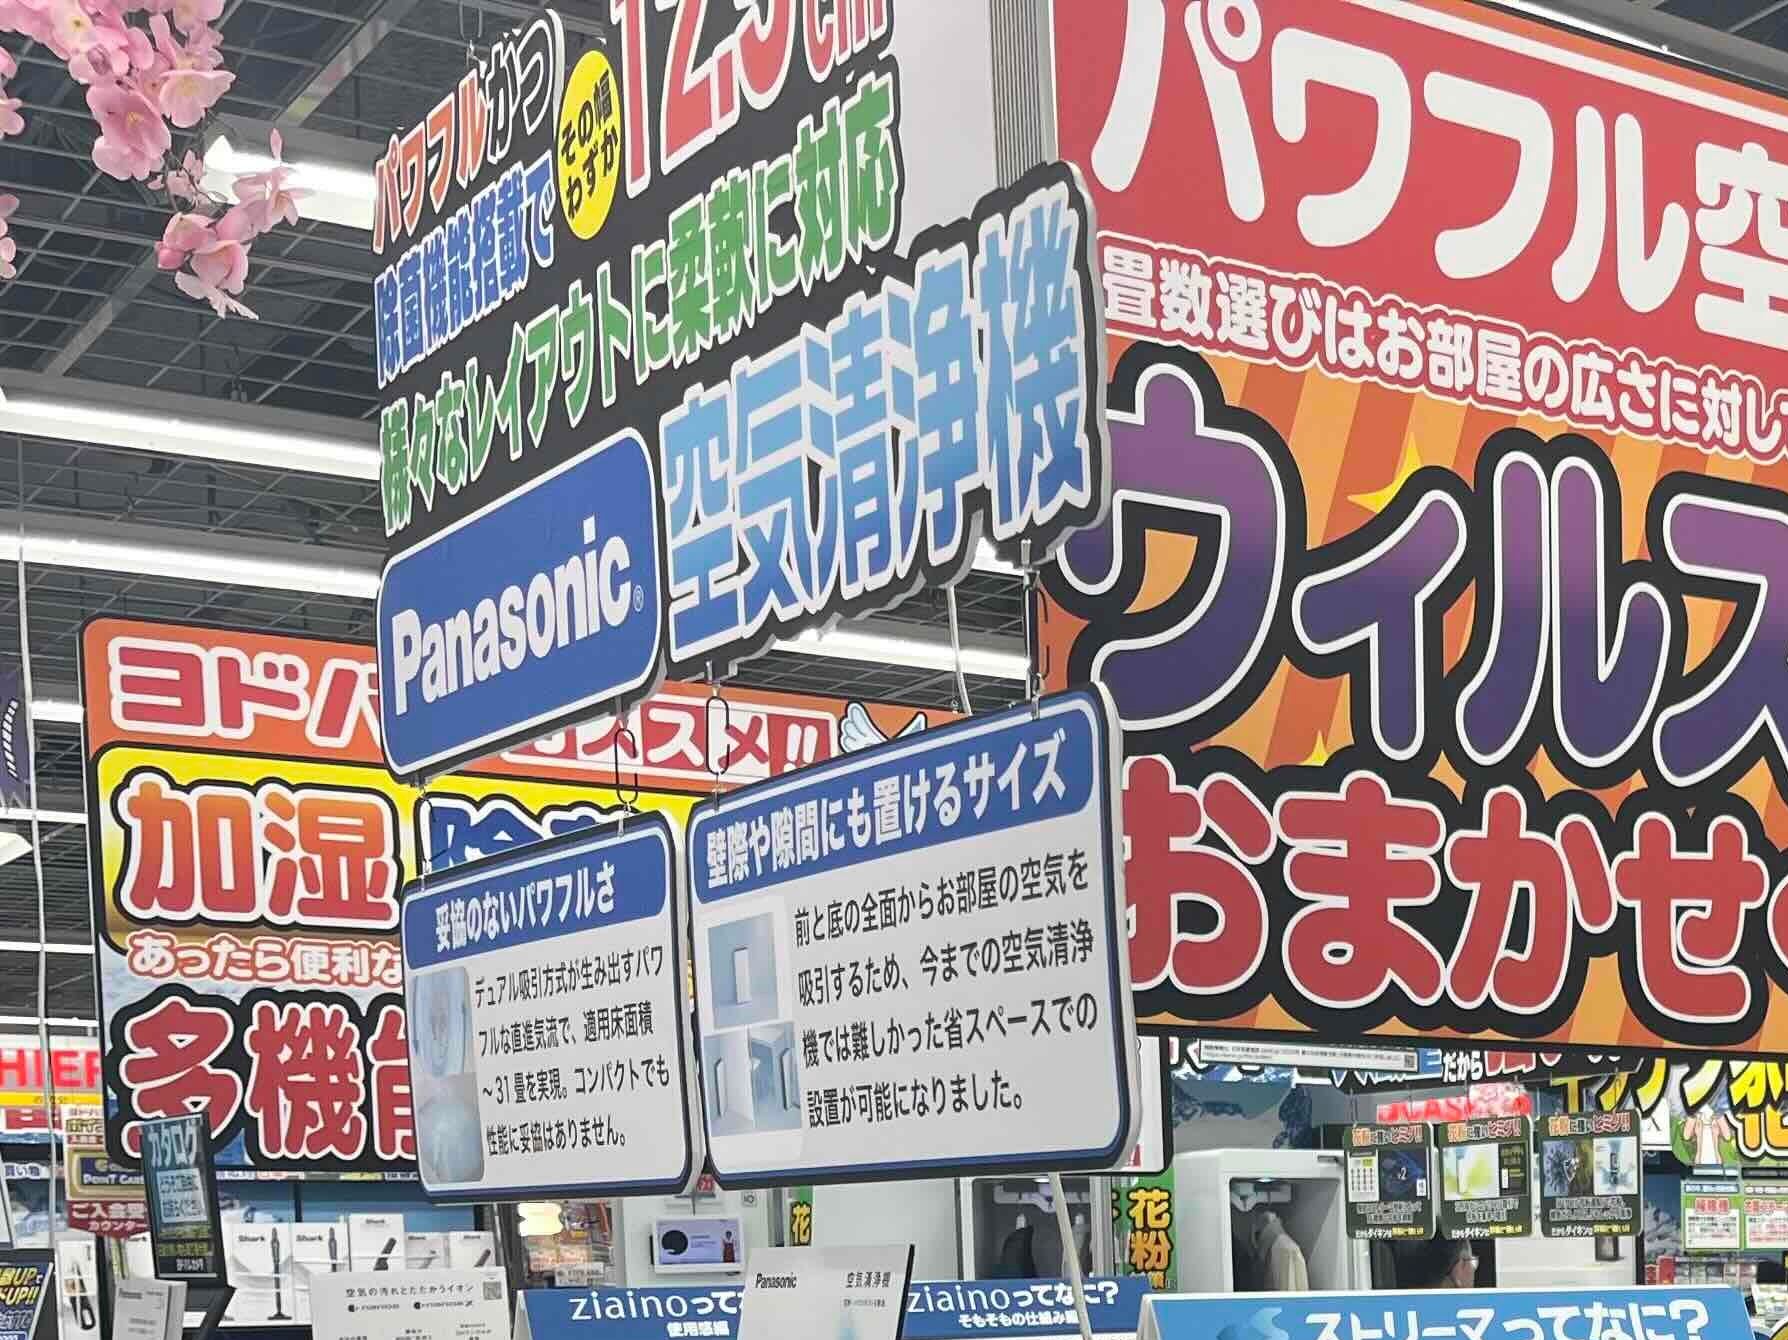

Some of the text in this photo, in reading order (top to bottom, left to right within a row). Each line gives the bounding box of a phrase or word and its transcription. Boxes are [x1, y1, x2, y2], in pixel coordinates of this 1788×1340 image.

[374, 150, 556, 390] 除菌機能搭載で
[378, 73, 897, 536] 様々なレイアウトに柔軟に対応
[658, 182, 1092, 664] 空気清浄機
[391, 517, 631, 717] Panasonic
[120, 777, 402, 926] 加湿
[705, 727, 1069, 889] 壁際や隙間にも置けるサイズ
[434, 860, 617, 953] 妥協のないパワフルさ
[792, 848, 1091, 948] 前と底の全面からお部屋の空気を
[473, 945, 664, 1009] デュアル吸引方式が生み出すパワ
[797, 917, 1095, 1009] 吸引するため、今までの空気清浄
[478, 1000, 654, 1058] フルな直進気流で、適用床面積
[800, 991, 1099, 1071] 機では難しかった省スペースでの
[485, 1113, 628, 1157] 性能に妥協はありません。
[805, 1069, 1024, 1130] 設置が可能になりました。
[345, 1283, 475, 1299] 空気の汚れとたたかうイオン
[754, 1272, 799, 1289] Panasonic
[845, 1271, 891, 1289] 空気清浄機
